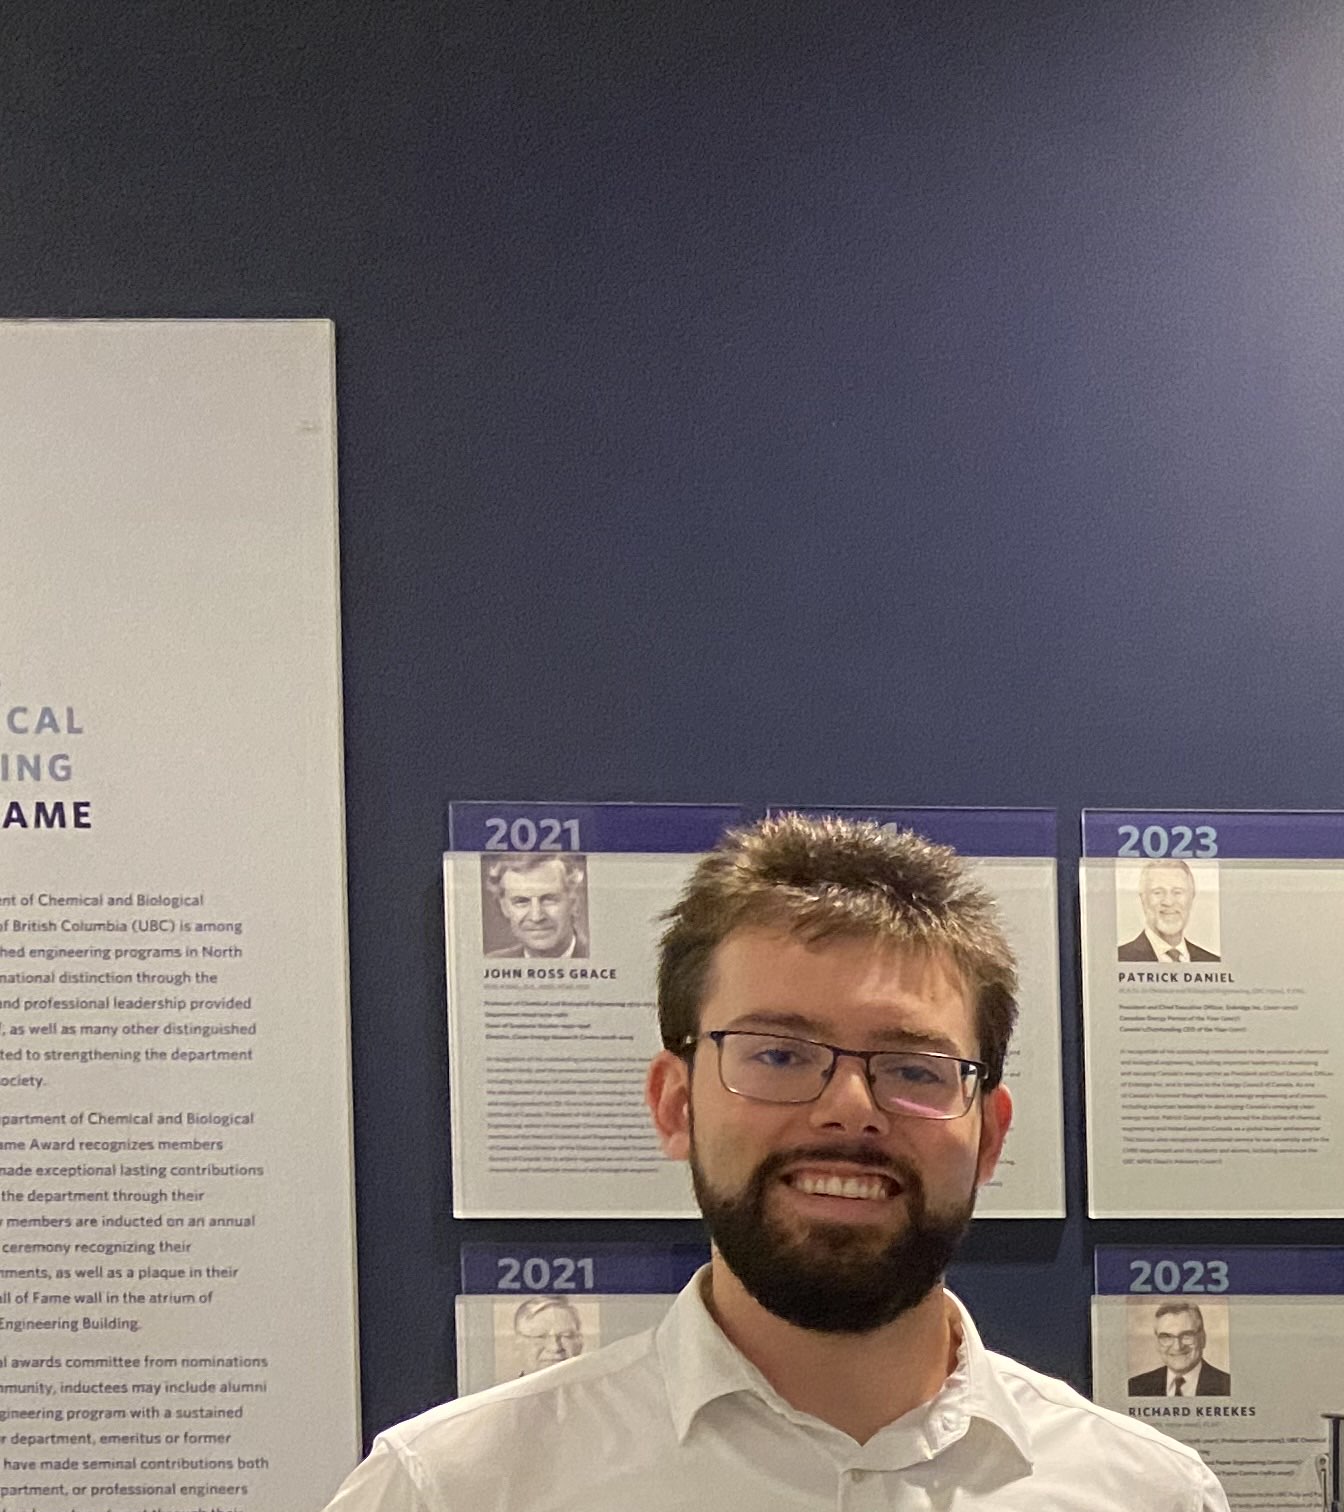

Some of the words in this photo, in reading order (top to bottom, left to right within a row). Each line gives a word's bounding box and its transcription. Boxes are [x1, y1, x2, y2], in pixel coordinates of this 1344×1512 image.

[7, 707, 83, 734] CAL
[1, 754, 71, 781] ING
[3, 802, 91, 828] AME
[485, 818, 580, 850] 2021
[1118, 825, 1218, 858] 2023
[21, 894, 33, 906] of
[38, 894, 103, 906] Chemical
[108, 894, 133, 906] and
[137, 894, 203, 908] Biological
[13, 920, 57, 932] British
[61, 920, 127, 932] Columbia
[132, 920, 175, 933] (UBC)
[180, 920, 191, 932] is
[195, 923, 242, 935] among
[29, 946, 111, 960] engineering
[115, 949, 182, 960] programs
[186, 947, 198, 957] in
[202, 946, 242, 957] North
[484, 969, 522, 979] JOHN
[527, 969, 565, 979] ROSS
[569, 969, 617, 979] GRACE
[1118, 972, 1179, 983] PATRICK
[1184, 972, 1235, 983] DANIEL
[30, 1138, 75, 1150] Award
[79, 1139, 154, 1152] recognizes
[158, 1139, 223, 1150] members
[497, 1258, 594, 1289] 2021
[1129, 1260, 1230, 1292] 2023
[12, 1356, 61, 1368] awards
[66, 1357, 140, 1368] committee
[144, 1355, 177, 1367] from
[181, 1356, 268, 1367] nominations
[1129, 1406, 1191, 1417] RICHARD
[1196, 1406, 1256, 1417] KEREKES
